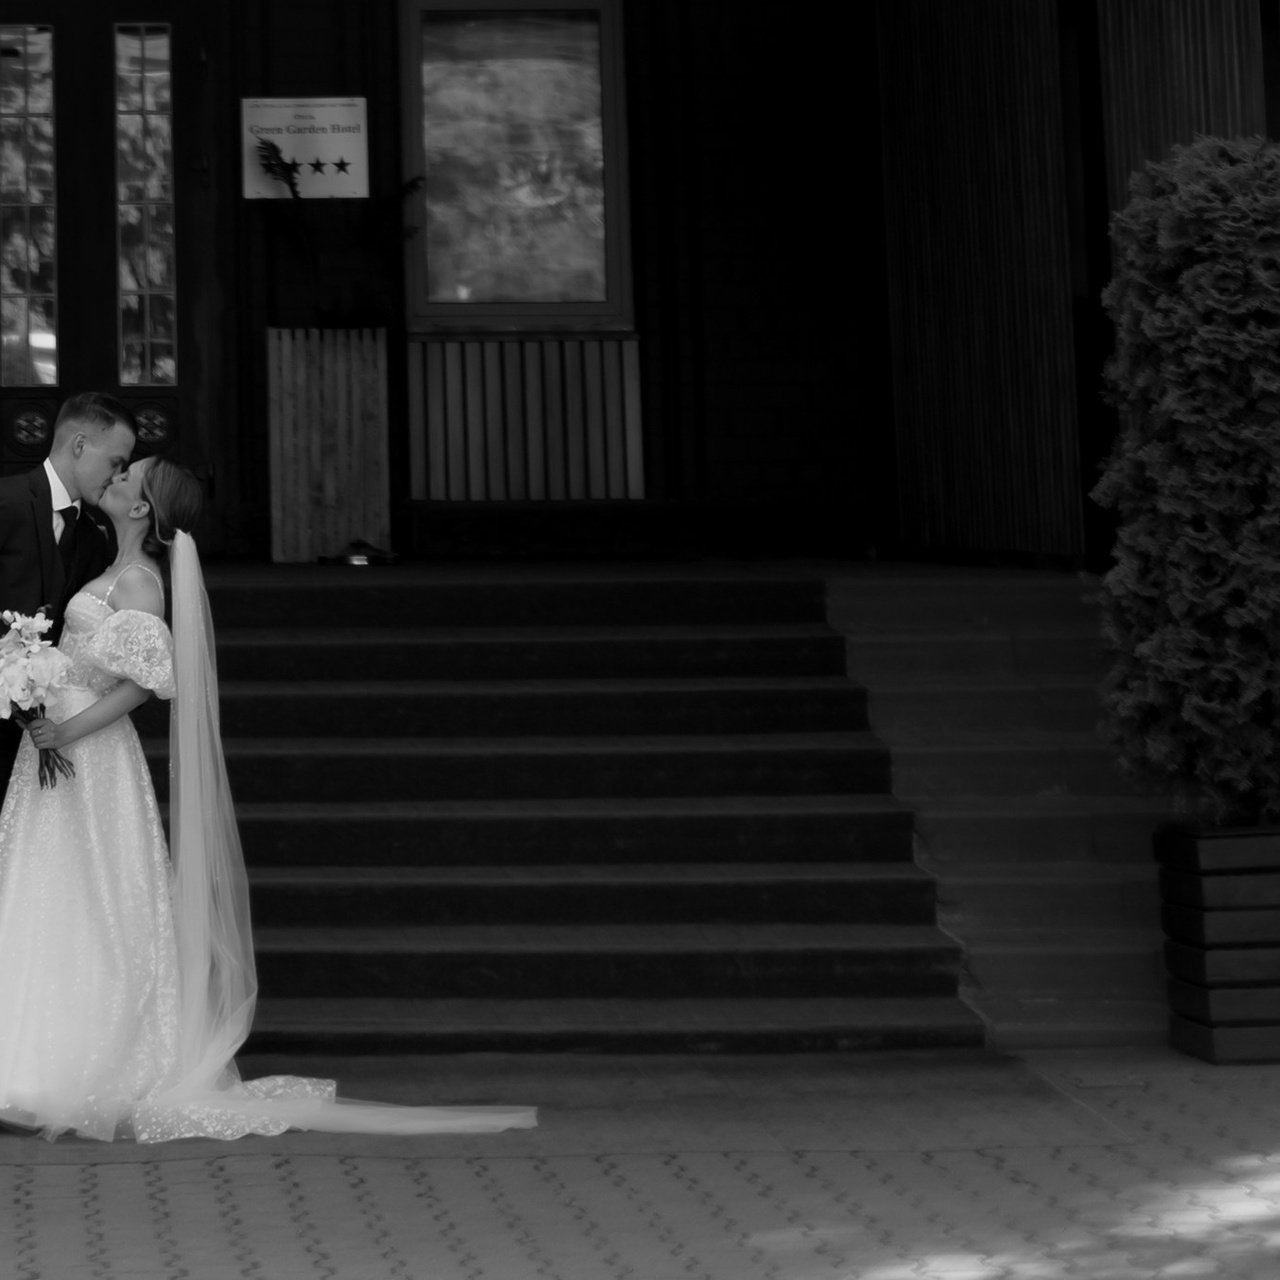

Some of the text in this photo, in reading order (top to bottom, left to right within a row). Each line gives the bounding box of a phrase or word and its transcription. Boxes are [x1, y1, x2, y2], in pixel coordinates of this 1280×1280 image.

[248, 124, 362, 136] Green Garden Hotel
